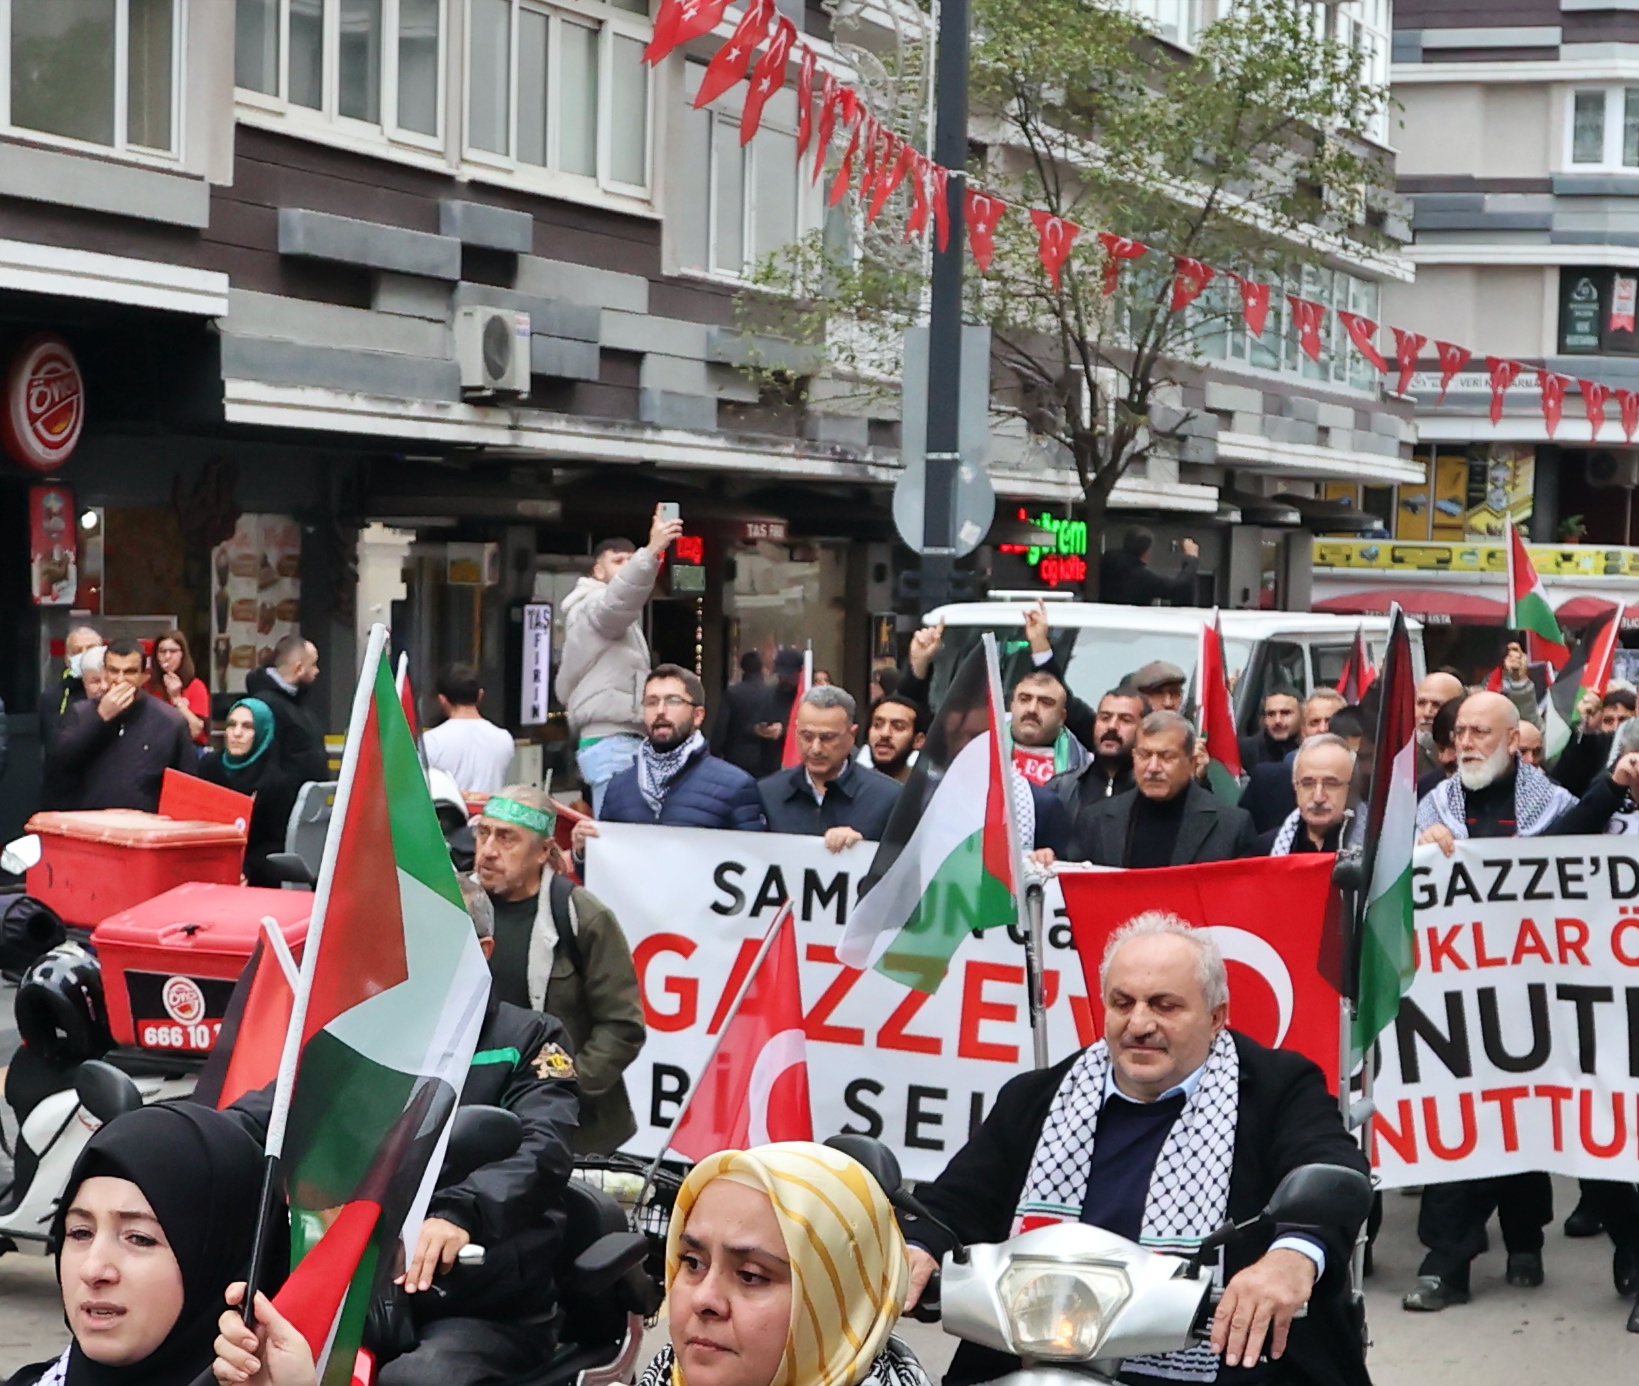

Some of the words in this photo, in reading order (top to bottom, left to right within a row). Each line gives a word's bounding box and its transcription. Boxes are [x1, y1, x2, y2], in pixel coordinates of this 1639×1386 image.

[1459, 374, 1483, 388] VERİ
[144, 1025, 184, 1048] 666
[188, 1024, 211, 1049] 10
